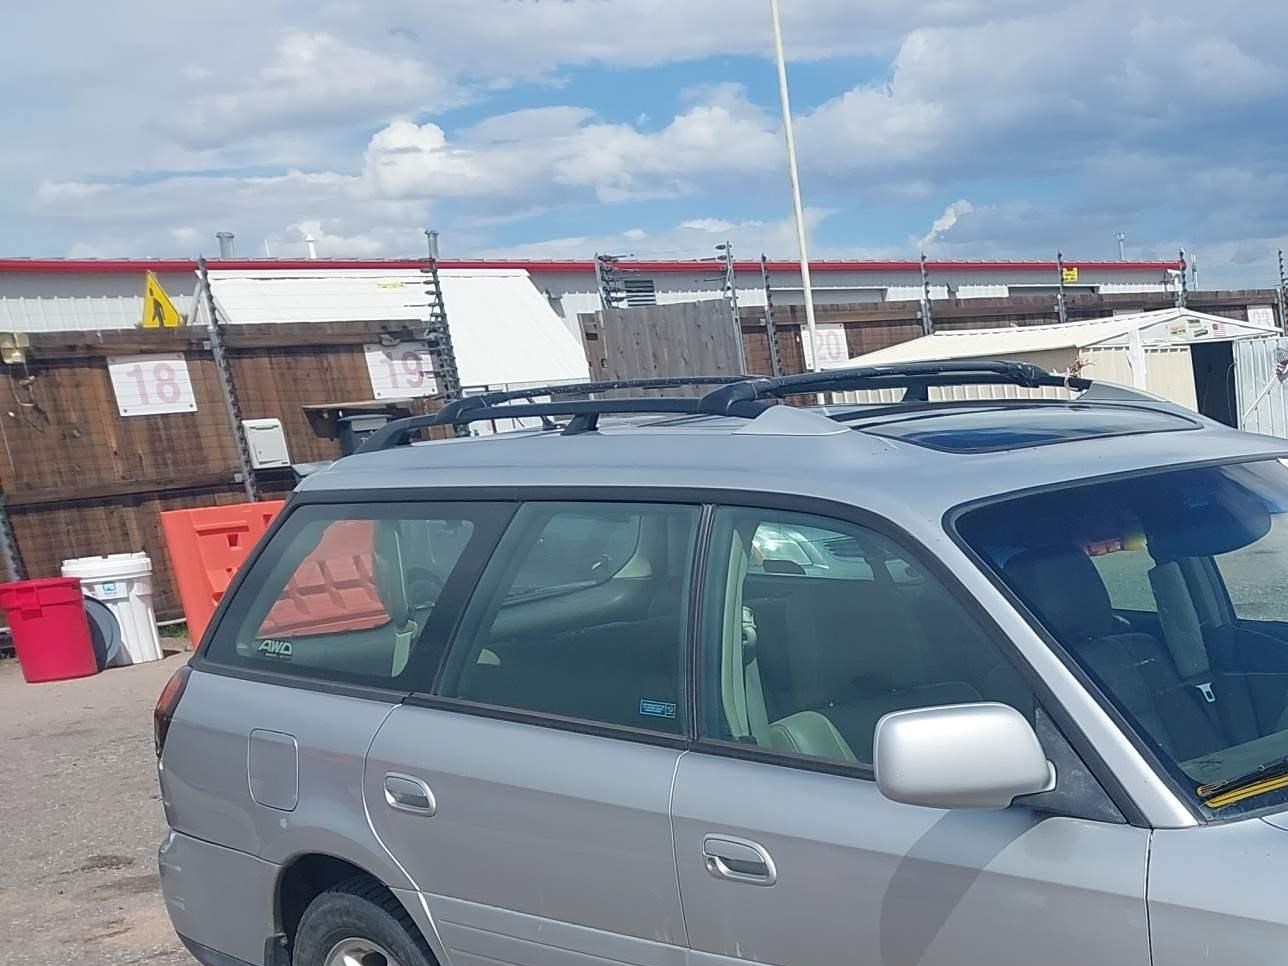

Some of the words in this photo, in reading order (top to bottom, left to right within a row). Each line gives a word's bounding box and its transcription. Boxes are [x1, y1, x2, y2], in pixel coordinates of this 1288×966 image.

[126, 364, 180, 405] 18
[379, 351, 424, 389] 19
[258, 640, 292, 655] AWD
